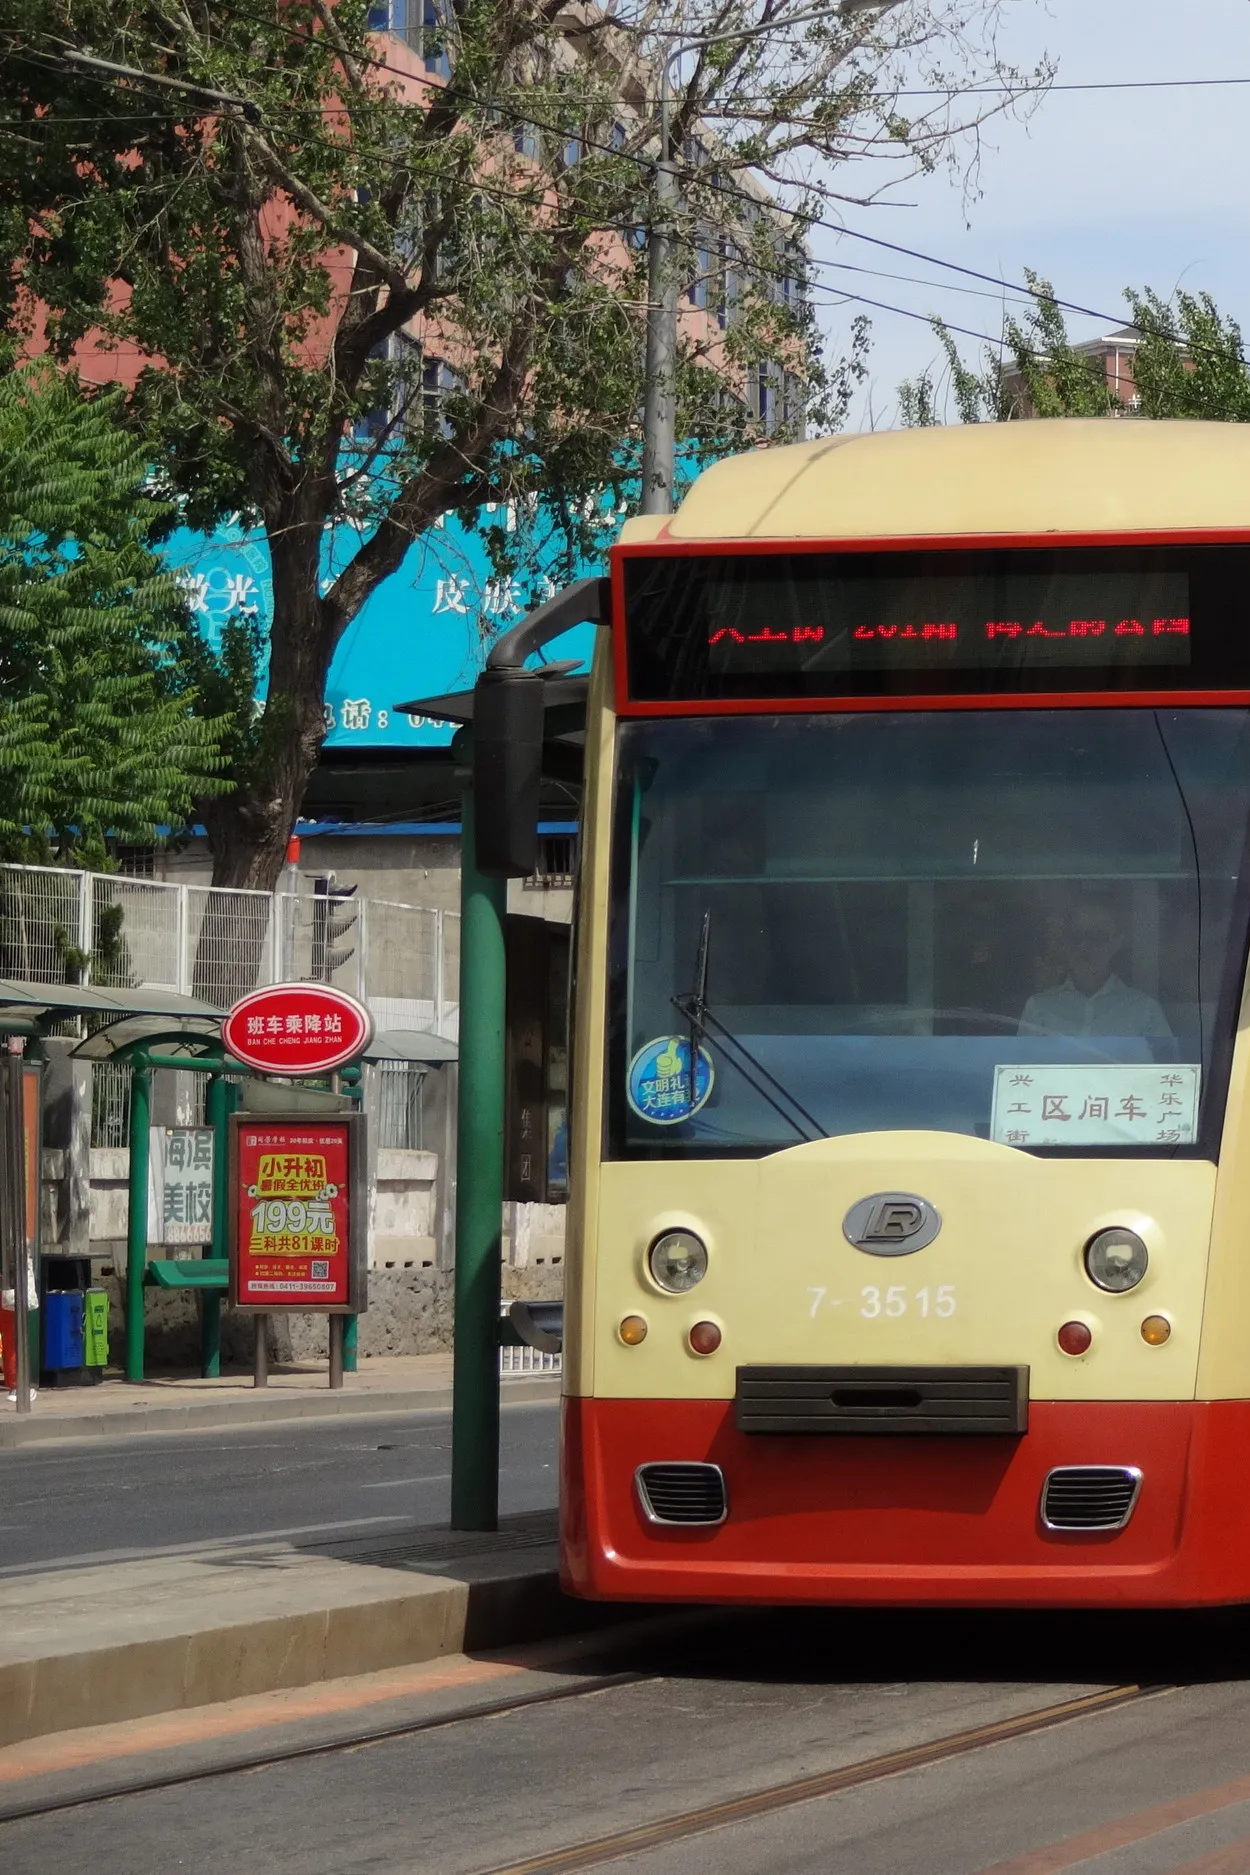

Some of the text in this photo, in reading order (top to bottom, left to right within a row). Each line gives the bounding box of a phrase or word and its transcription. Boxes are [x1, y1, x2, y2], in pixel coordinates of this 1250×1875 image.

[247, 1013, 342, 1035] 班车乘降站
[263, 1037, 276, 1045] CHE
[303, 1036, 322, 1044] JIANG
[324, 1035, 342, 1043] ZHAN
[1006, 1074, 1034, 1142] 兴工街
[1041, 1094, 1147, 1121] 区间车
[1156, 1073, 1183, 1141] 华乐广场
[262, 1156, 324, 1178] 小升初
[251, 1199, 335, 1234] 199元
[249, 1236, 339, 1252] 三科共81课时
